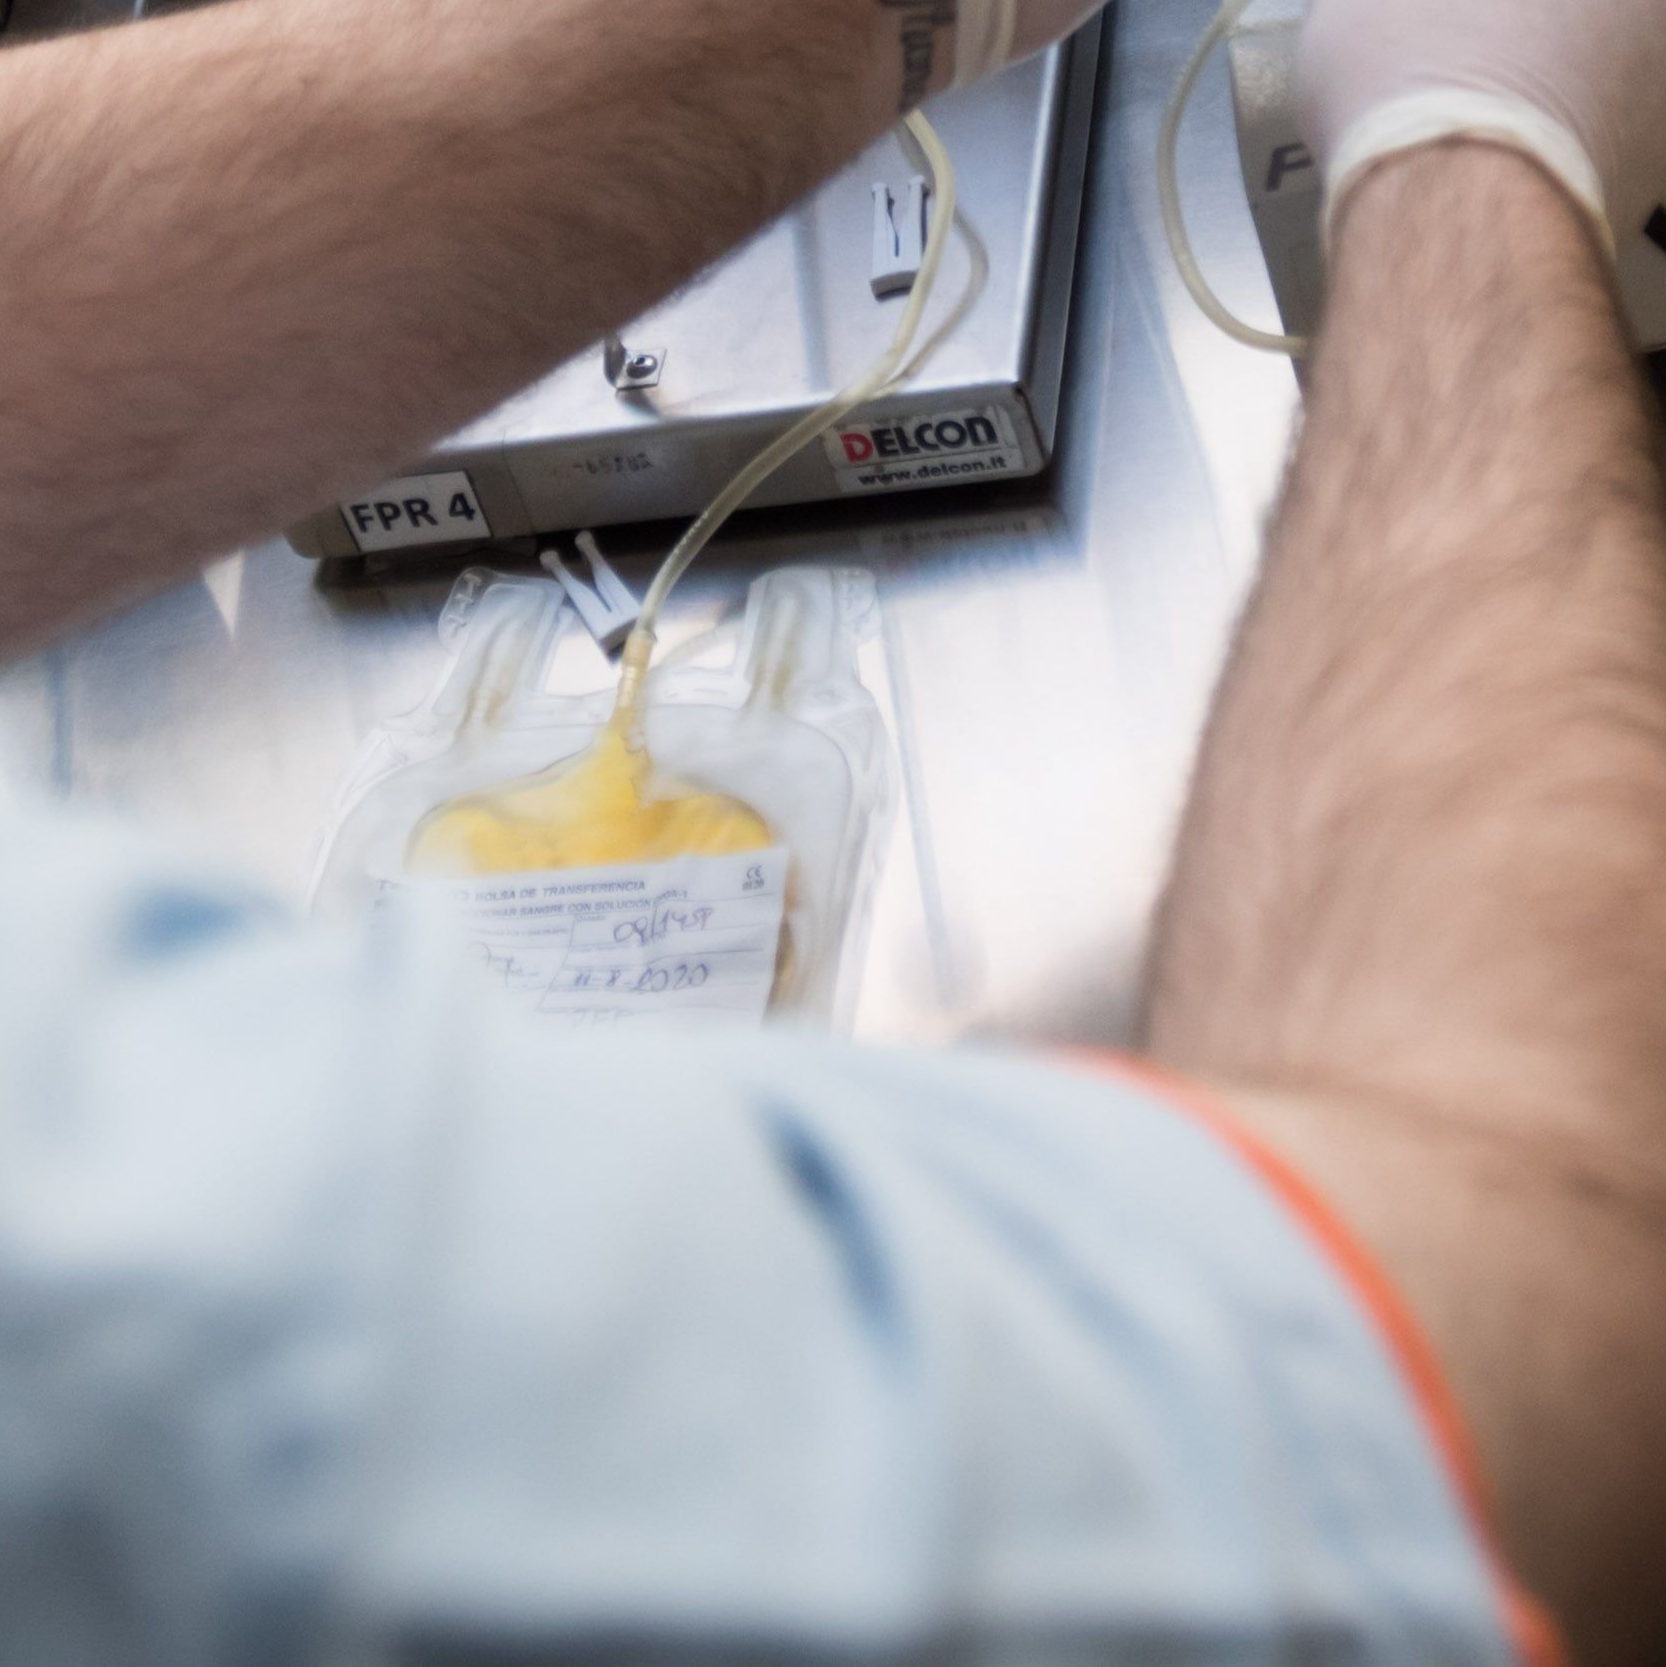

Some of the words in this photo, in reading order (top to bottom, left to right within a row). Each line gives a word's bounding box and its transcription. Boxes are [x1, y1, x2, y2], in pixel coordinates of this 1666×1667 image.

[842, 414, 1000, 465] DELCON
[857, 454, 1007, 488] www.delcon.it
[350, 496, 439, 534] FPR
[447, 492, 477, 522] 4
[474, 890, 516, 902] BOLSA
[520, 888, 537, 899] DE
[542, 881, 646, 897] TRANSFERENCIA
[519, 904, 564, 916] SANGRE
[567, 901, 592, 913] CON
